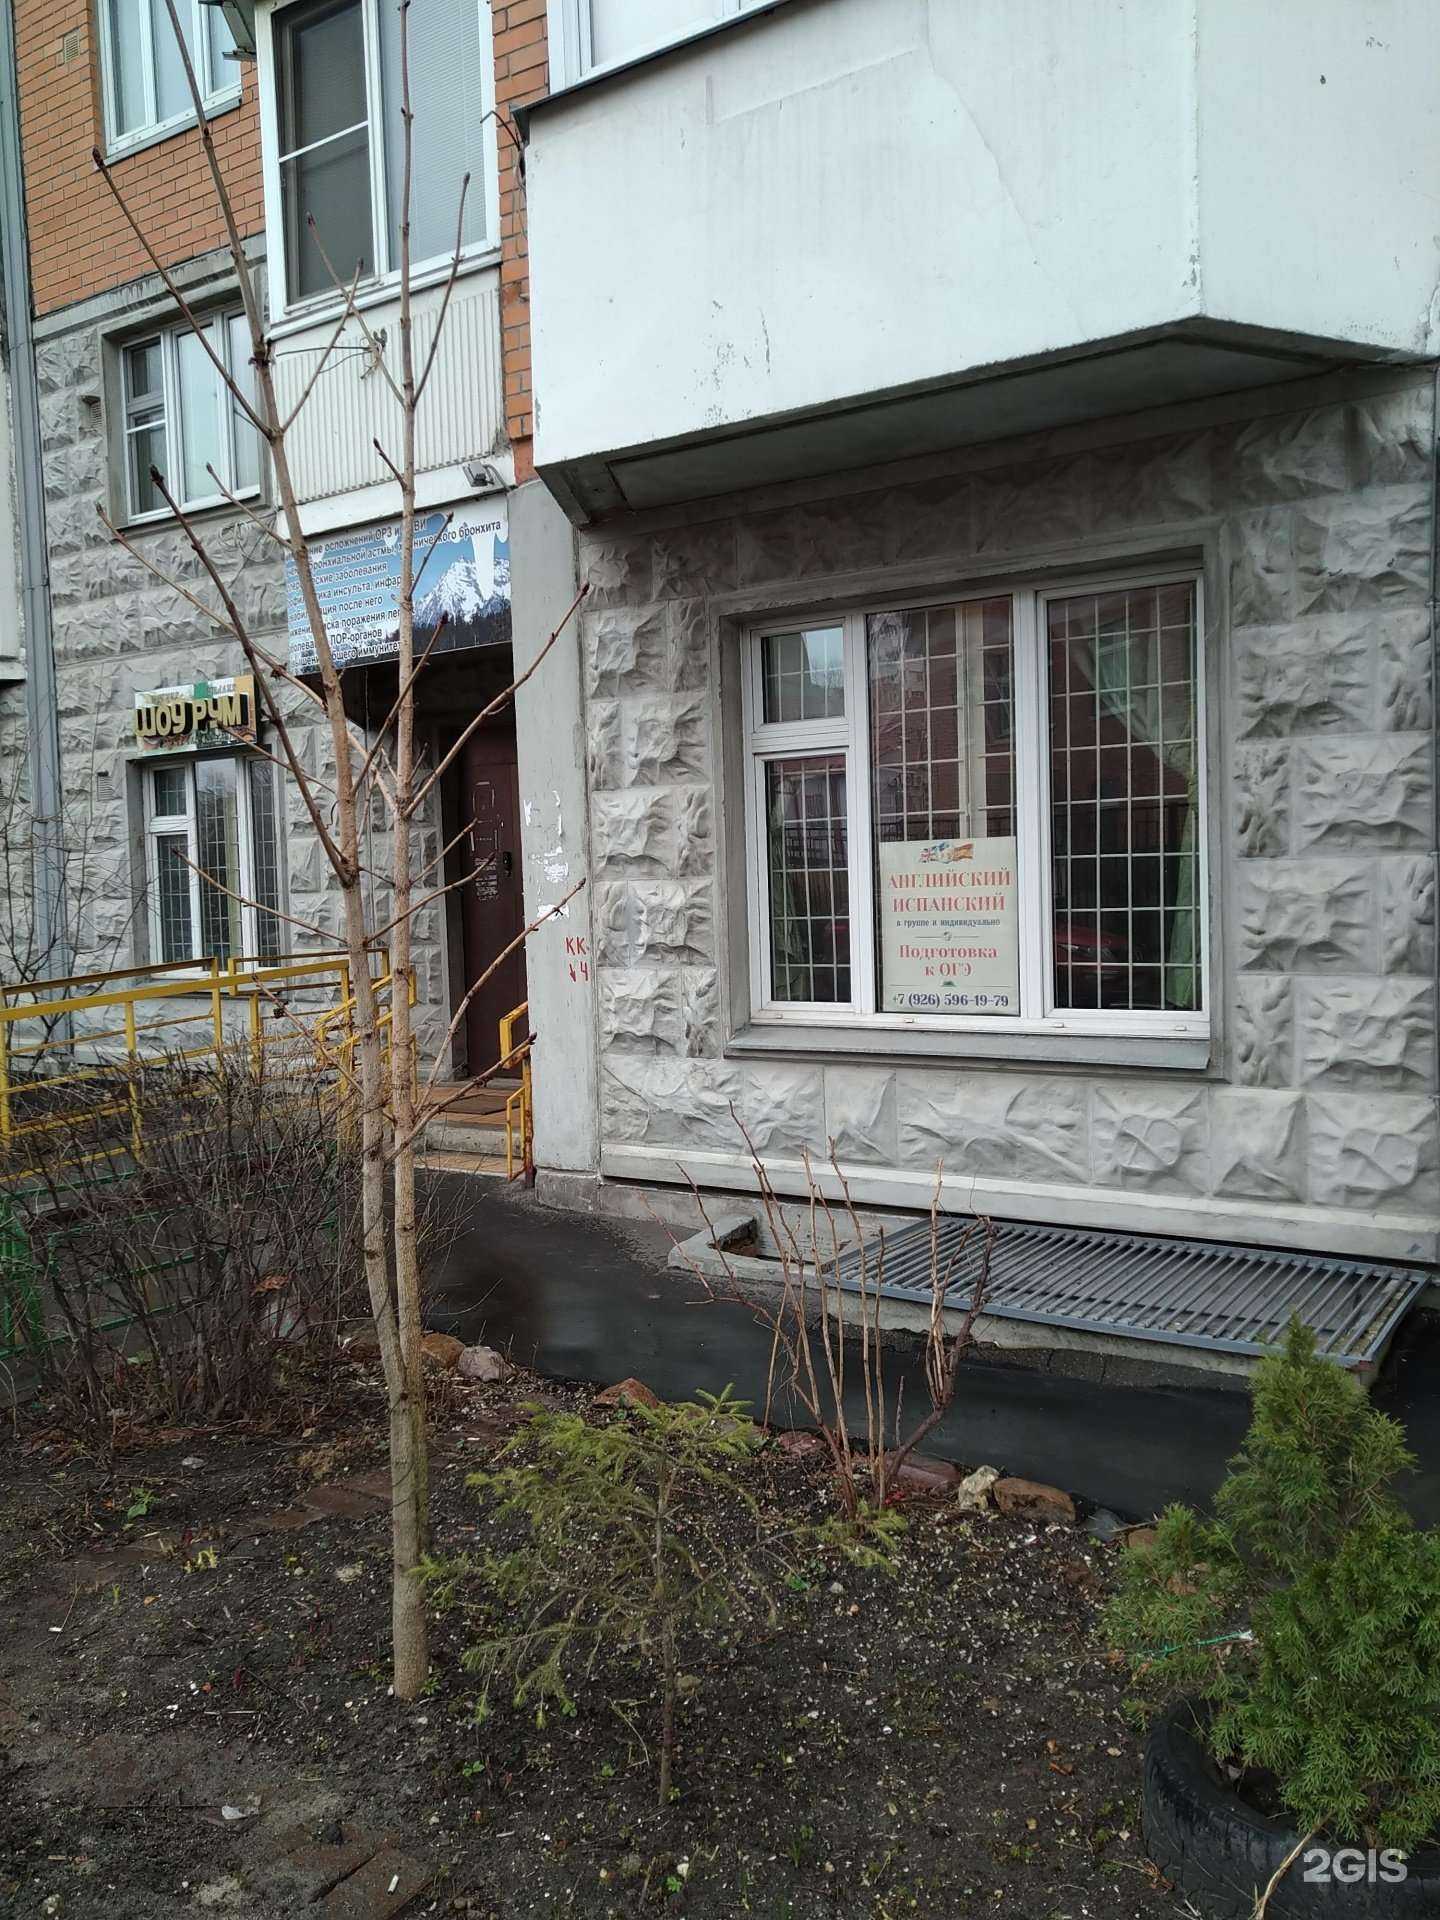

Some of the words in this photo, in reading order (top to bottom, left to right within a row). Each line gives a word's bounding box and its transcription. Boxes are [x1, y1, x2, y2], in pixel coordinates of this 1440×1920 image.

[375, 526, 393, 540] ОРЗ
[459, 520, 501, 539] бронхита
[335, 562, 388, 582] заболевания
[339, 599, 363, 613] после
[364, 595, 383, 608] него
[341, 610, 386, 628] поражения
[330, 628, 383, 646] ЛОР-органов
[331, 647, 357, 661] бщего
[135, 700, 187, 737] ШОУ
[192, 694, 242, 730] РУМ
[888, 865, 1011, 889] АНГЛИЙСКИЙ
[893, 891, 1006, 913] ИСПАНСКИЙ
[903, 919, 930, 929] группе
[940, 918, 1001, 928] индивидуально
[899, 944, 998, 961] Подготовка
[925, 965, 935, 977] к
[939, 961, 972, 977] ОГЭ
[908, 992, 940, 1008] (926)
[944, 992, 1010, 1007] 596-19-79
